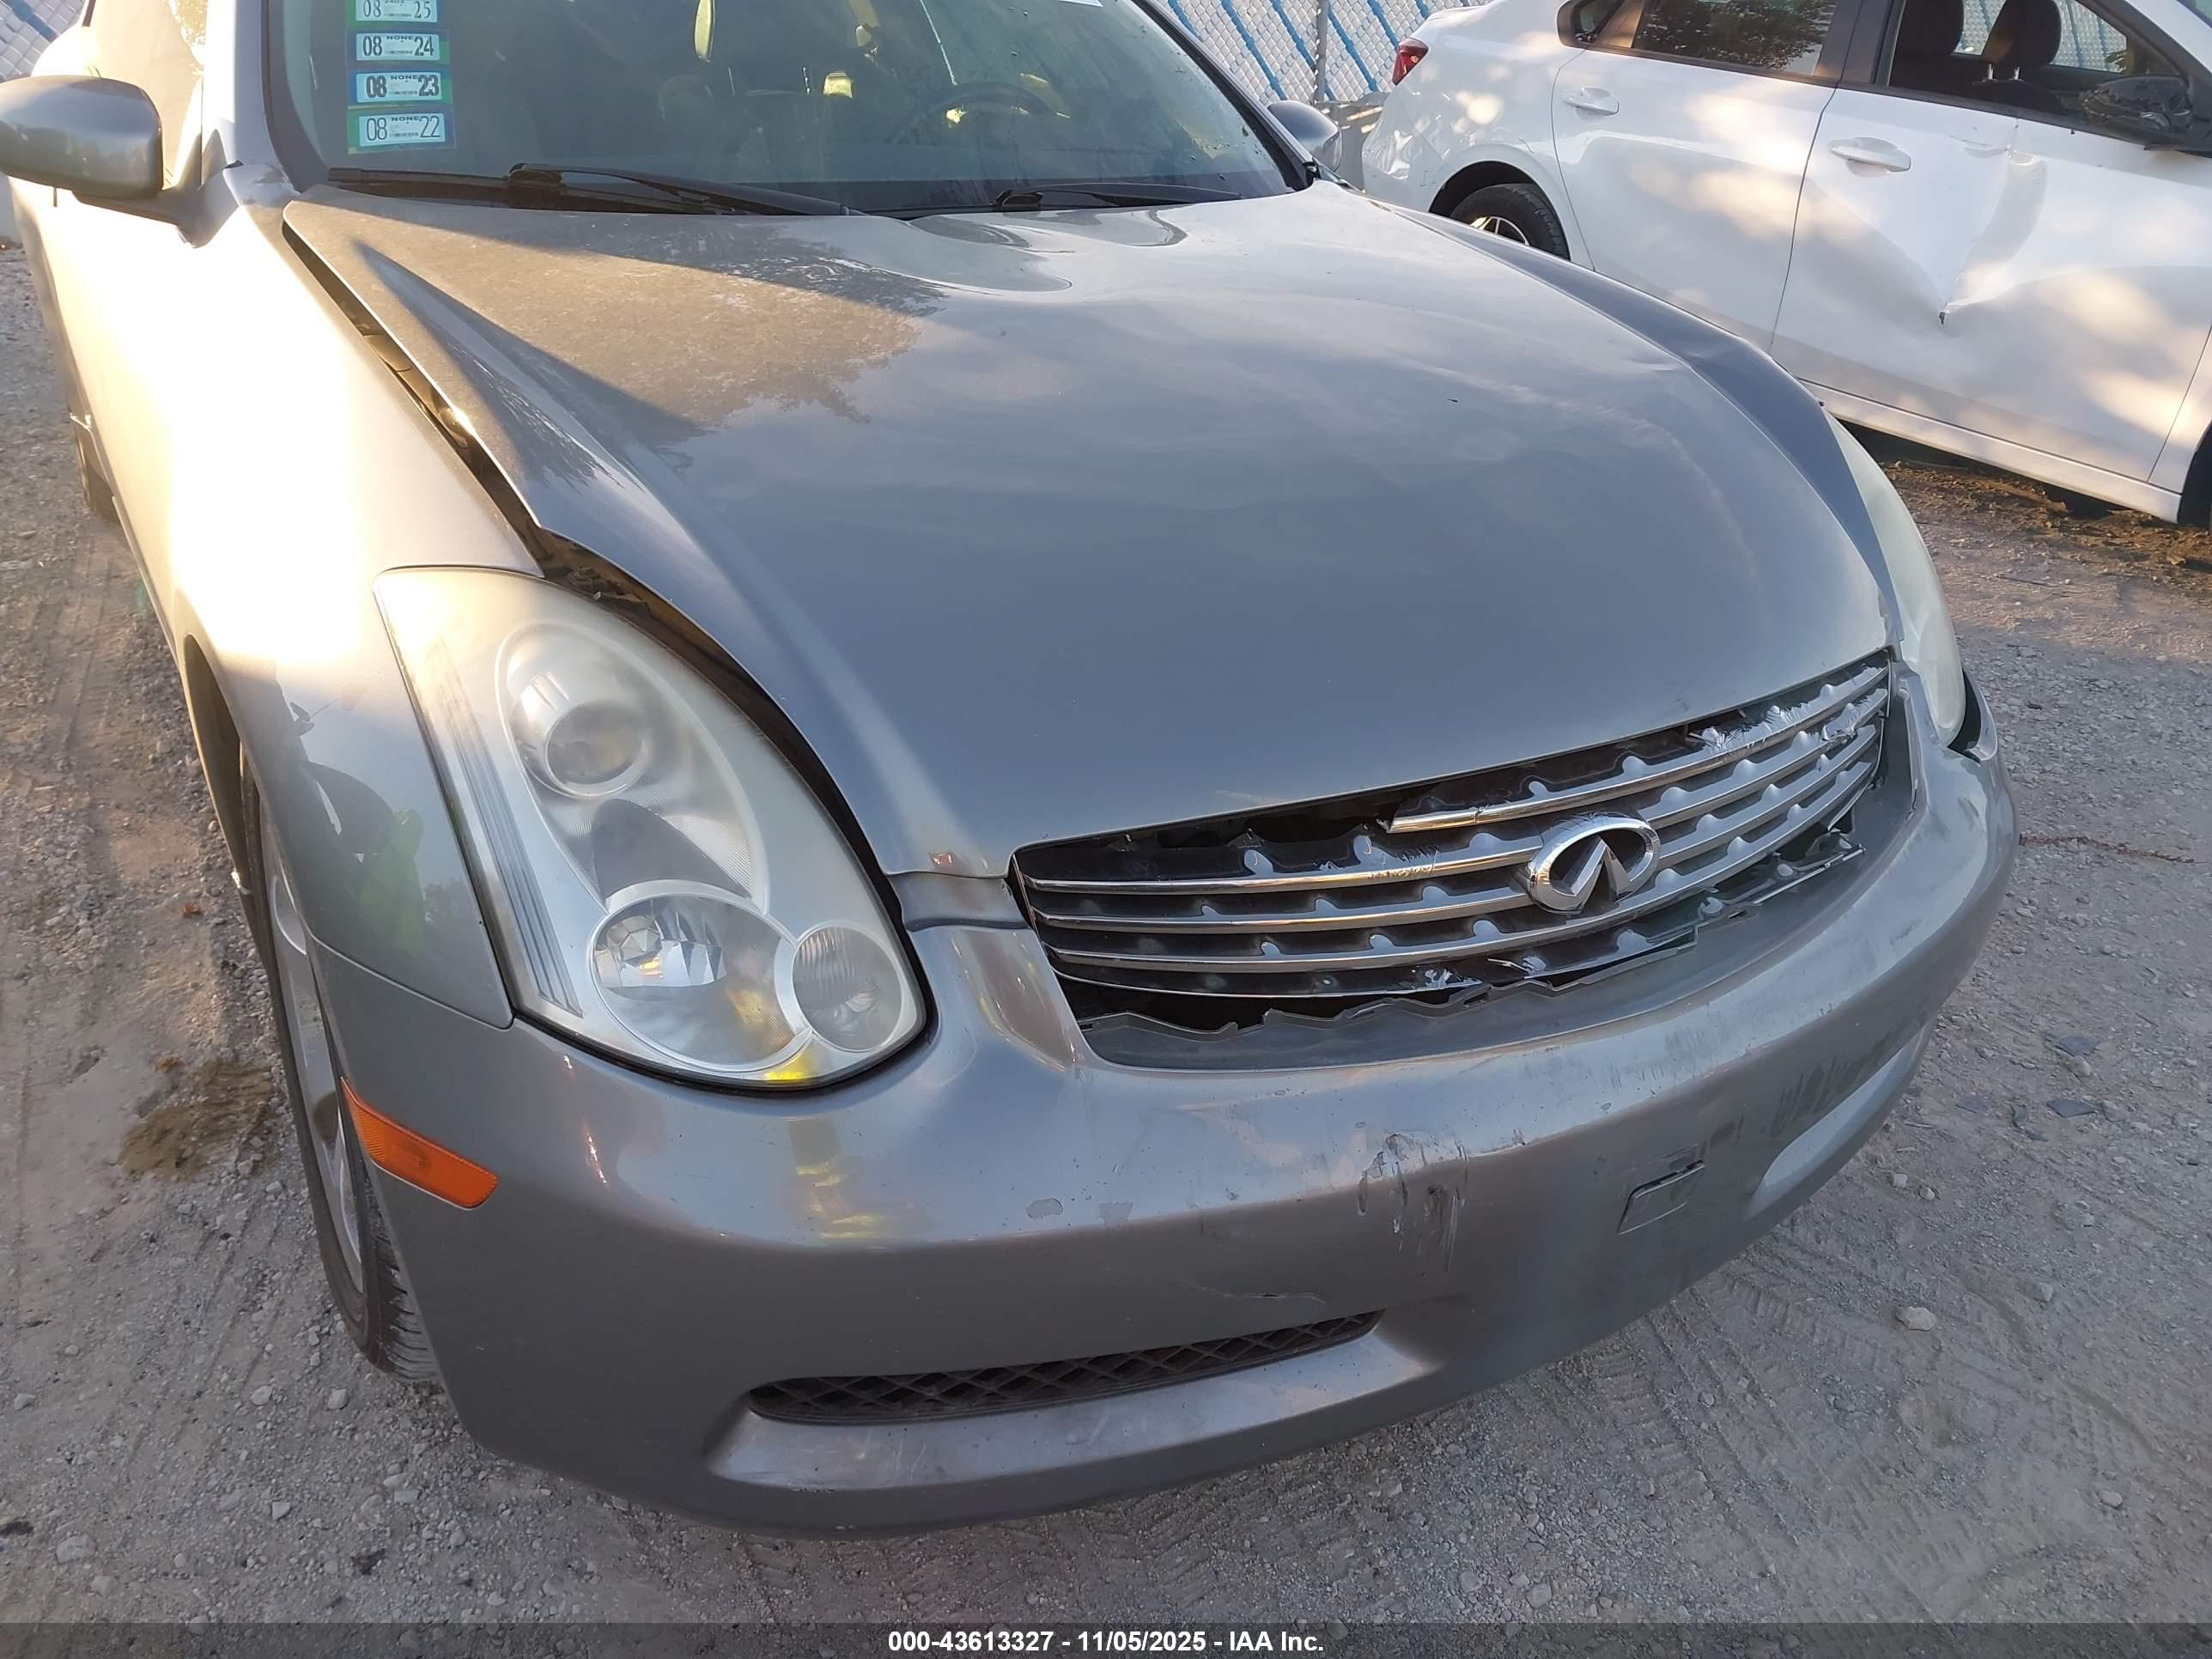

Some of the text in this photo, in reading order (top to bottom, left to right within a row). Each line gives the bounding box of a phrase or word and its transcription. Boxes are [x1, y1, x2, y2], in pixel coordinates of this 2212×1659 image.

[363, 0, 431, 18] 08 25
[362, 35, 434, 56] 08 24
[366, 74, 440, 98] 08 23
[367, 116, 441, 141] 08 22
